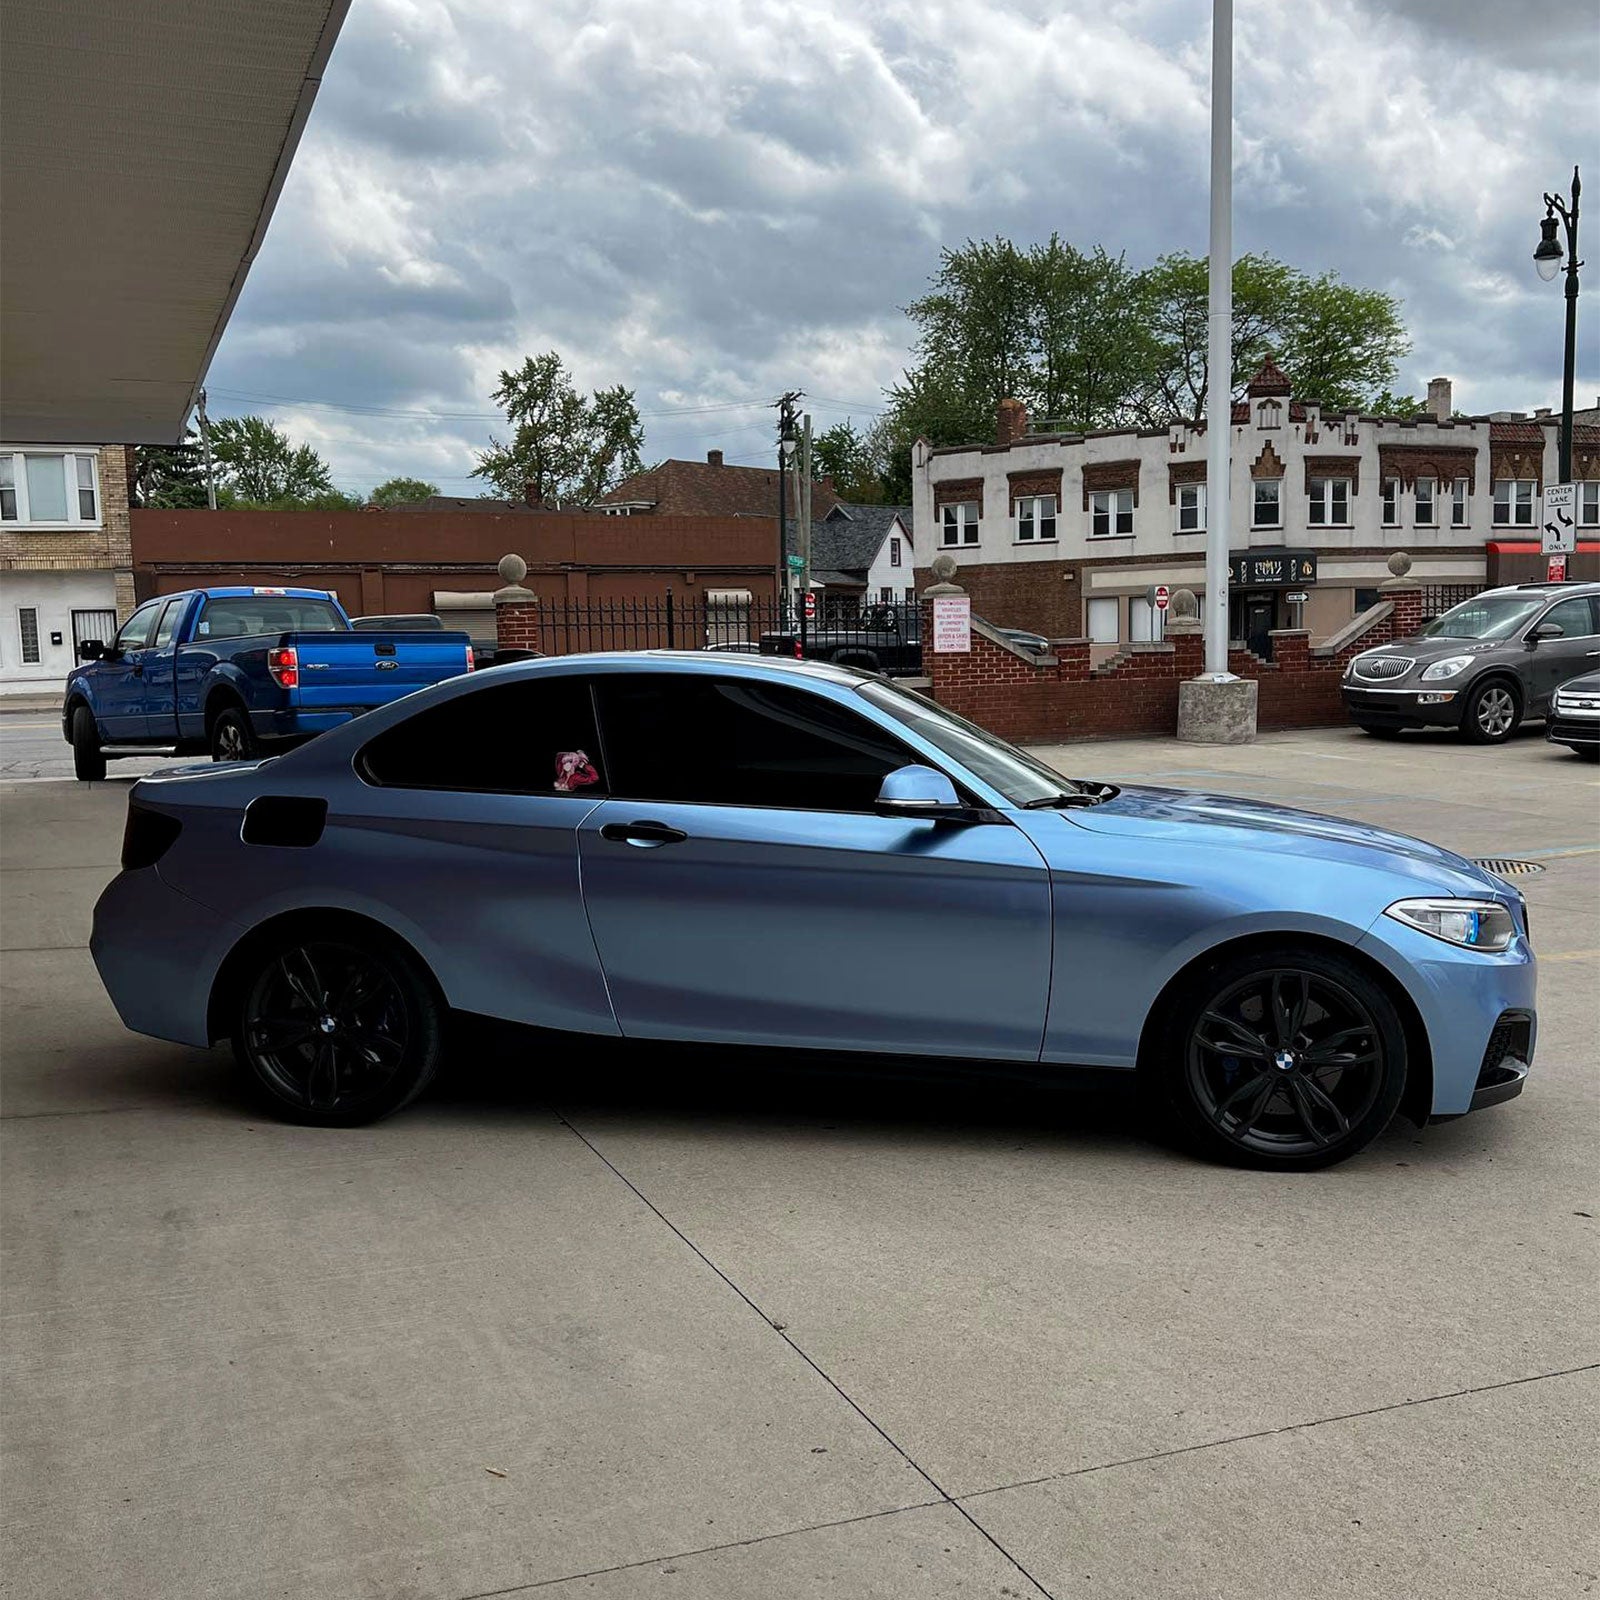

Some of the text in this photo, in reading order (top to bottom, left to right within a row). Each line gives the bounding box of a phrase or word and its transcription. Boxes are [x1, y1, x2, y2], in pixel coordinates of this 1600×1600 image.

[1547, 487, 1573, 496] CENTER
[1550, 496, 1568, 504] LANE
[1549, 543, 1567, 551] ONLY
